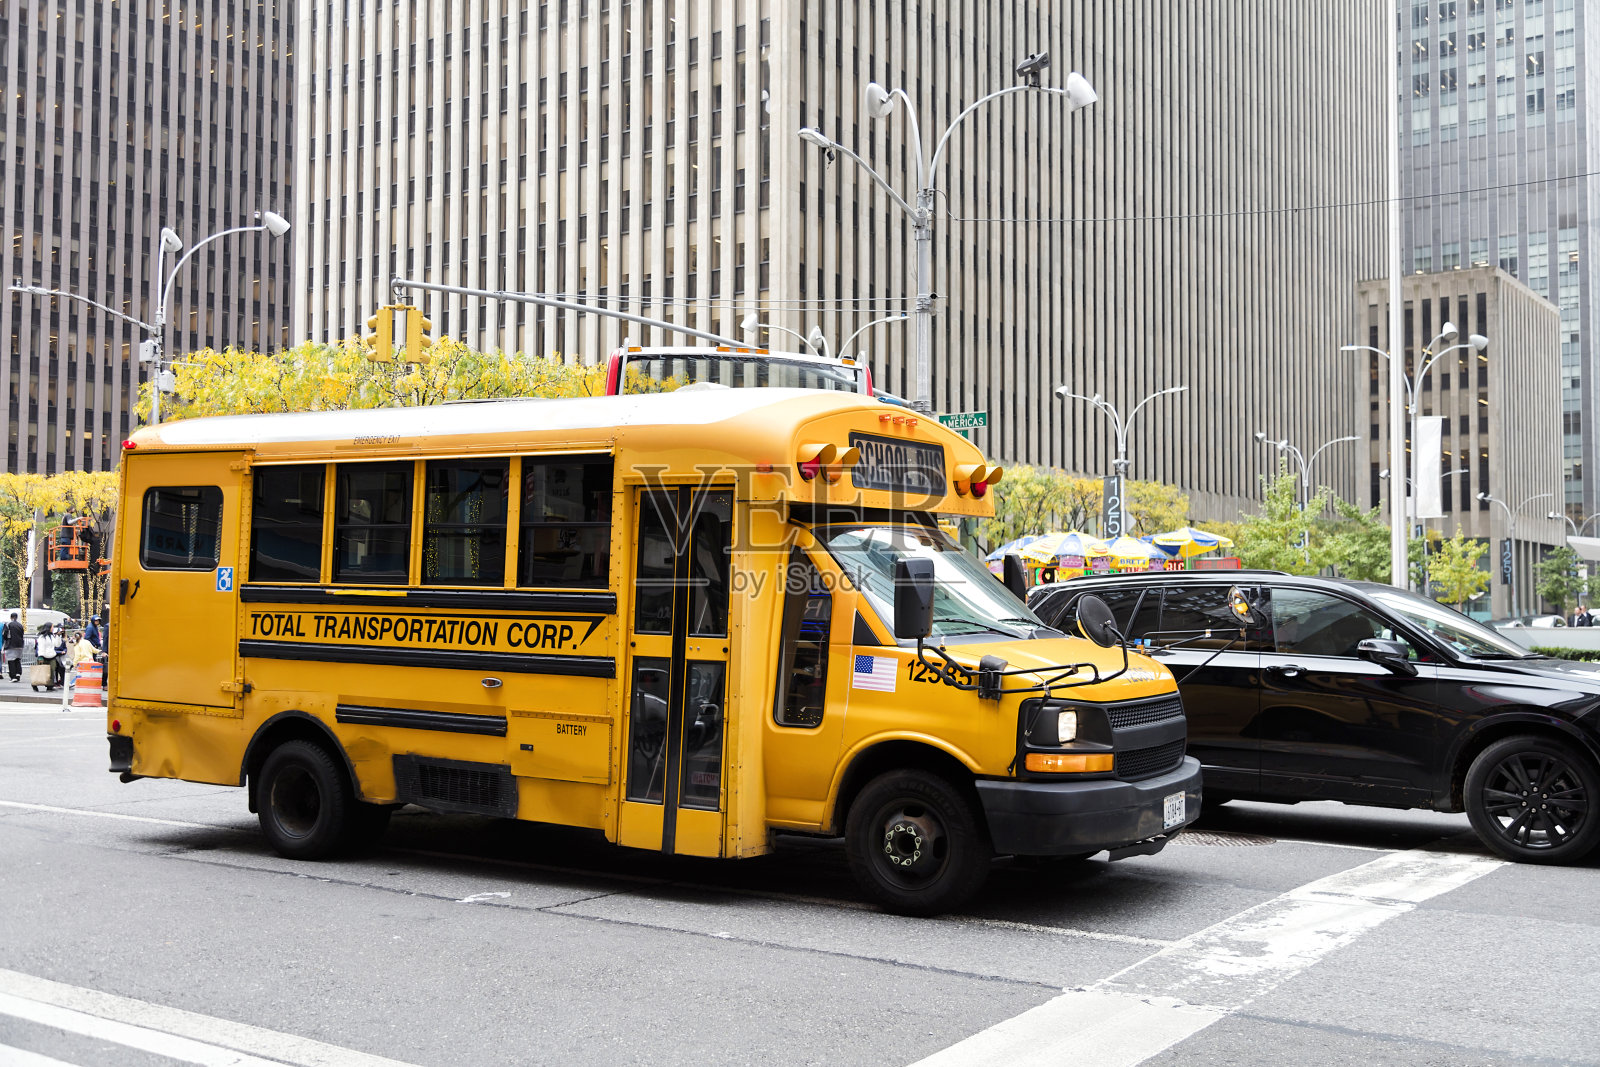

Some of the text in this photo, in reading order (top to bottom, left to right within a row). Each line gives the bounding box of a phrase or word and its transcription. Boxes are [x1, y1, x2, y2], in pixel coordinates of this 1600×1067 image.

[942, 417, 984, 428] AMERICAS
[853, 440, 914, 486] SCHOOL
[1107, 477, 1120, 538] 125
[1503, 541, 1512, 585] 1251
[251, 613, 577, 650] TOTAL TRANSPORTATION CORP.
[907, 659, 973, 686] 12585
[556, 723, 587, 737] BATTERY
